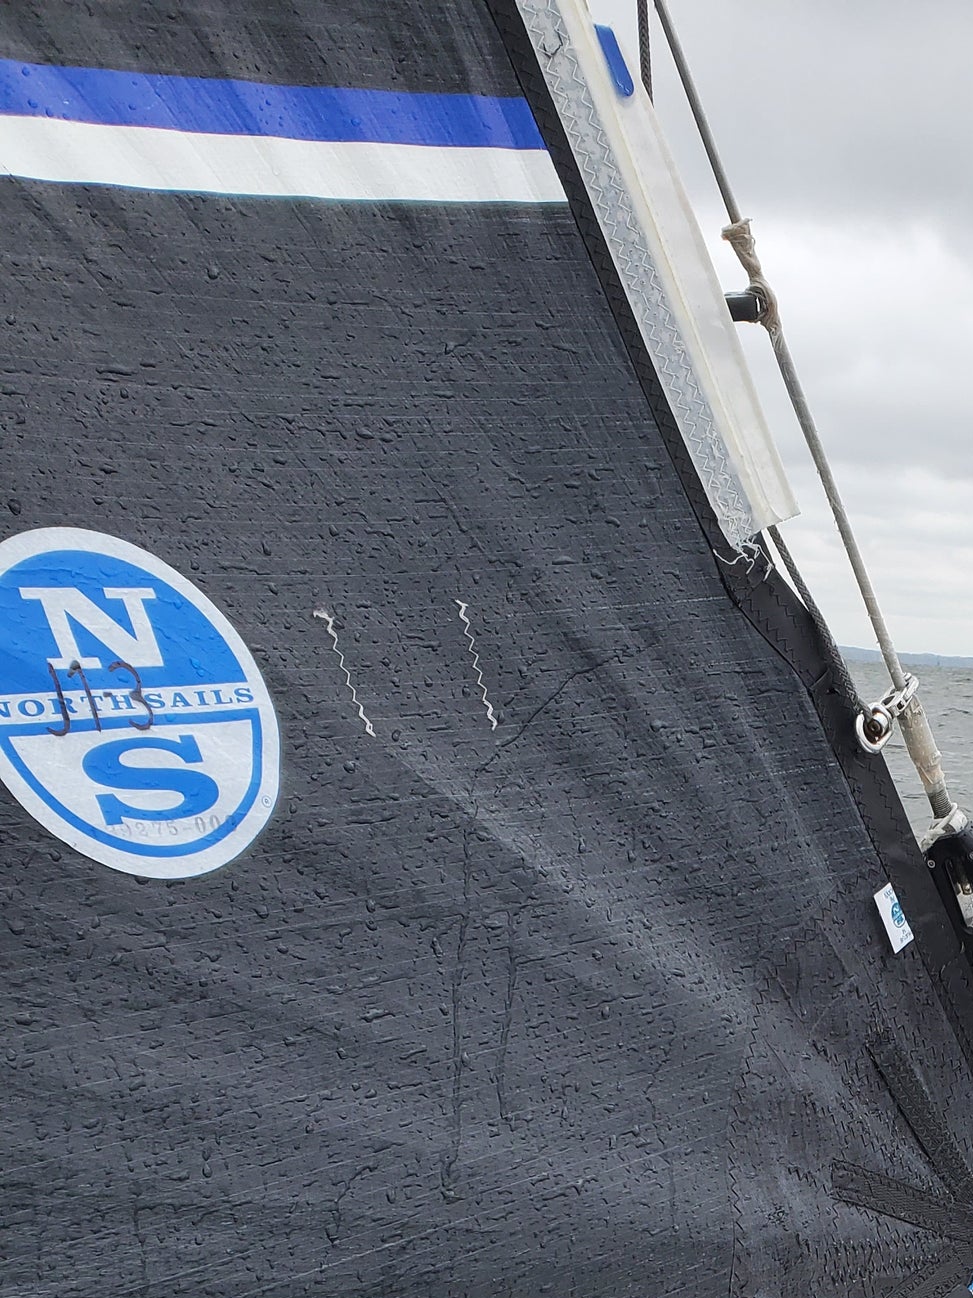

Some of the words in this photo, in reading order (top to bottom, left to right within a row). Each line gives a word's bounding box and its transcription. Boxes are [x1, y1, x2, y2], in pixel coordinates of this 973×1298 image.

[19, 587, 164, 670] N
[144, 687, 254, 709] SAILS
[82, 734, 219, 825] S
